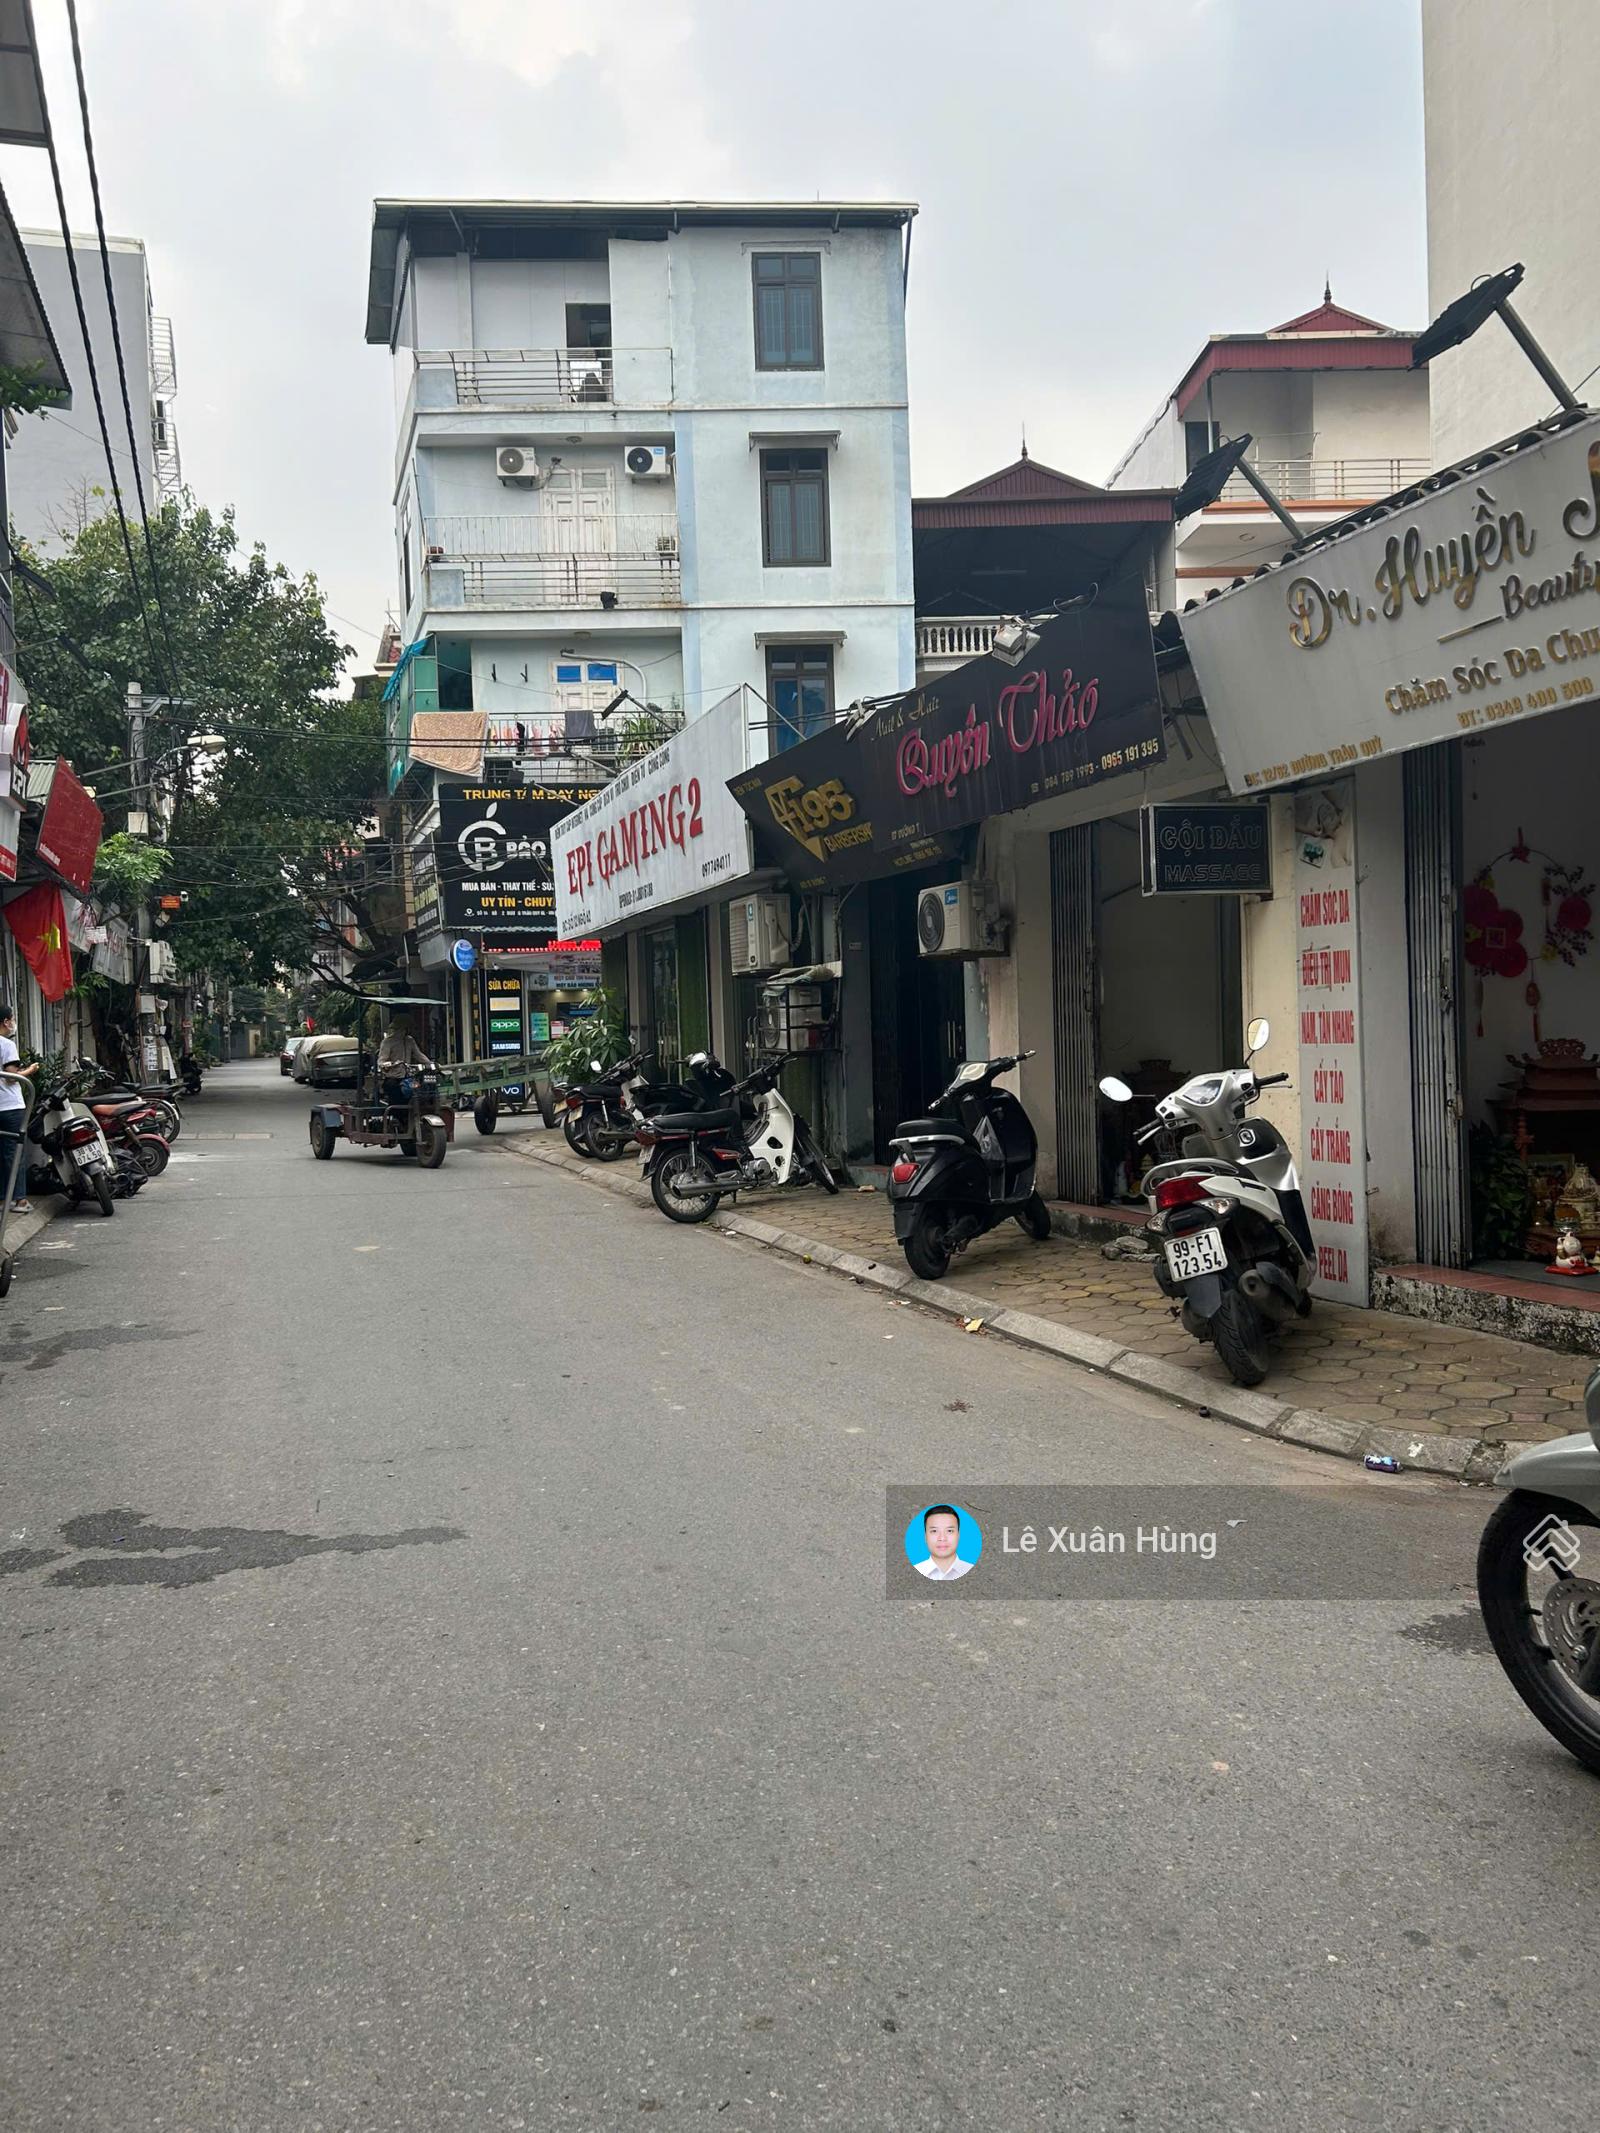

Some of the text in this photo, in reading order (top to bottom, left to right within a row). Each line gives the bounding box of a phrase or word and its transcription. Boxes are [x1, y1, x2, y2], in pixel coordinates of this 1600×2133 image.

[1375, 487, 1537, 620] Huyền
[1384, 677, 1452, 715] Chăm
[1452, 657, 1501, 694] Sóc
[1503, 646, 1545, 678] Da
[1101, 749, 1123, 771] 0965
[1124, 744, 1140, 764] 191
[1141, 738, 1160, 758] 395
[463, 788, 511, 800] TRUNG
[566, 841, 594, 903] EPI
[597, 784, 687, 889] GAMING
[688, 777, 703, 839] 2
[462, 882, 479, 891] MUA
[480, 879, 496, 891] BÁN
[502, 881, 520, 891] THAY
[1164, 864, 1262, 883] MASSAGE
[481, 897, 495, 907] UY
[498, 895, 516, 907] TÍN
[524, 897, 554, 907] CHUY
[1322, 884, 1337, 926] SÓC
[1339, 889, 1350, 923] DA
[1332, 1009, 1354, 1044] NHANG
[1173, 1234, 1213, 1259] 99-F1
[1174, 1252, 1222, 1277] 123.54
[1319, 1246, 1348, 1283] PEEL DA
